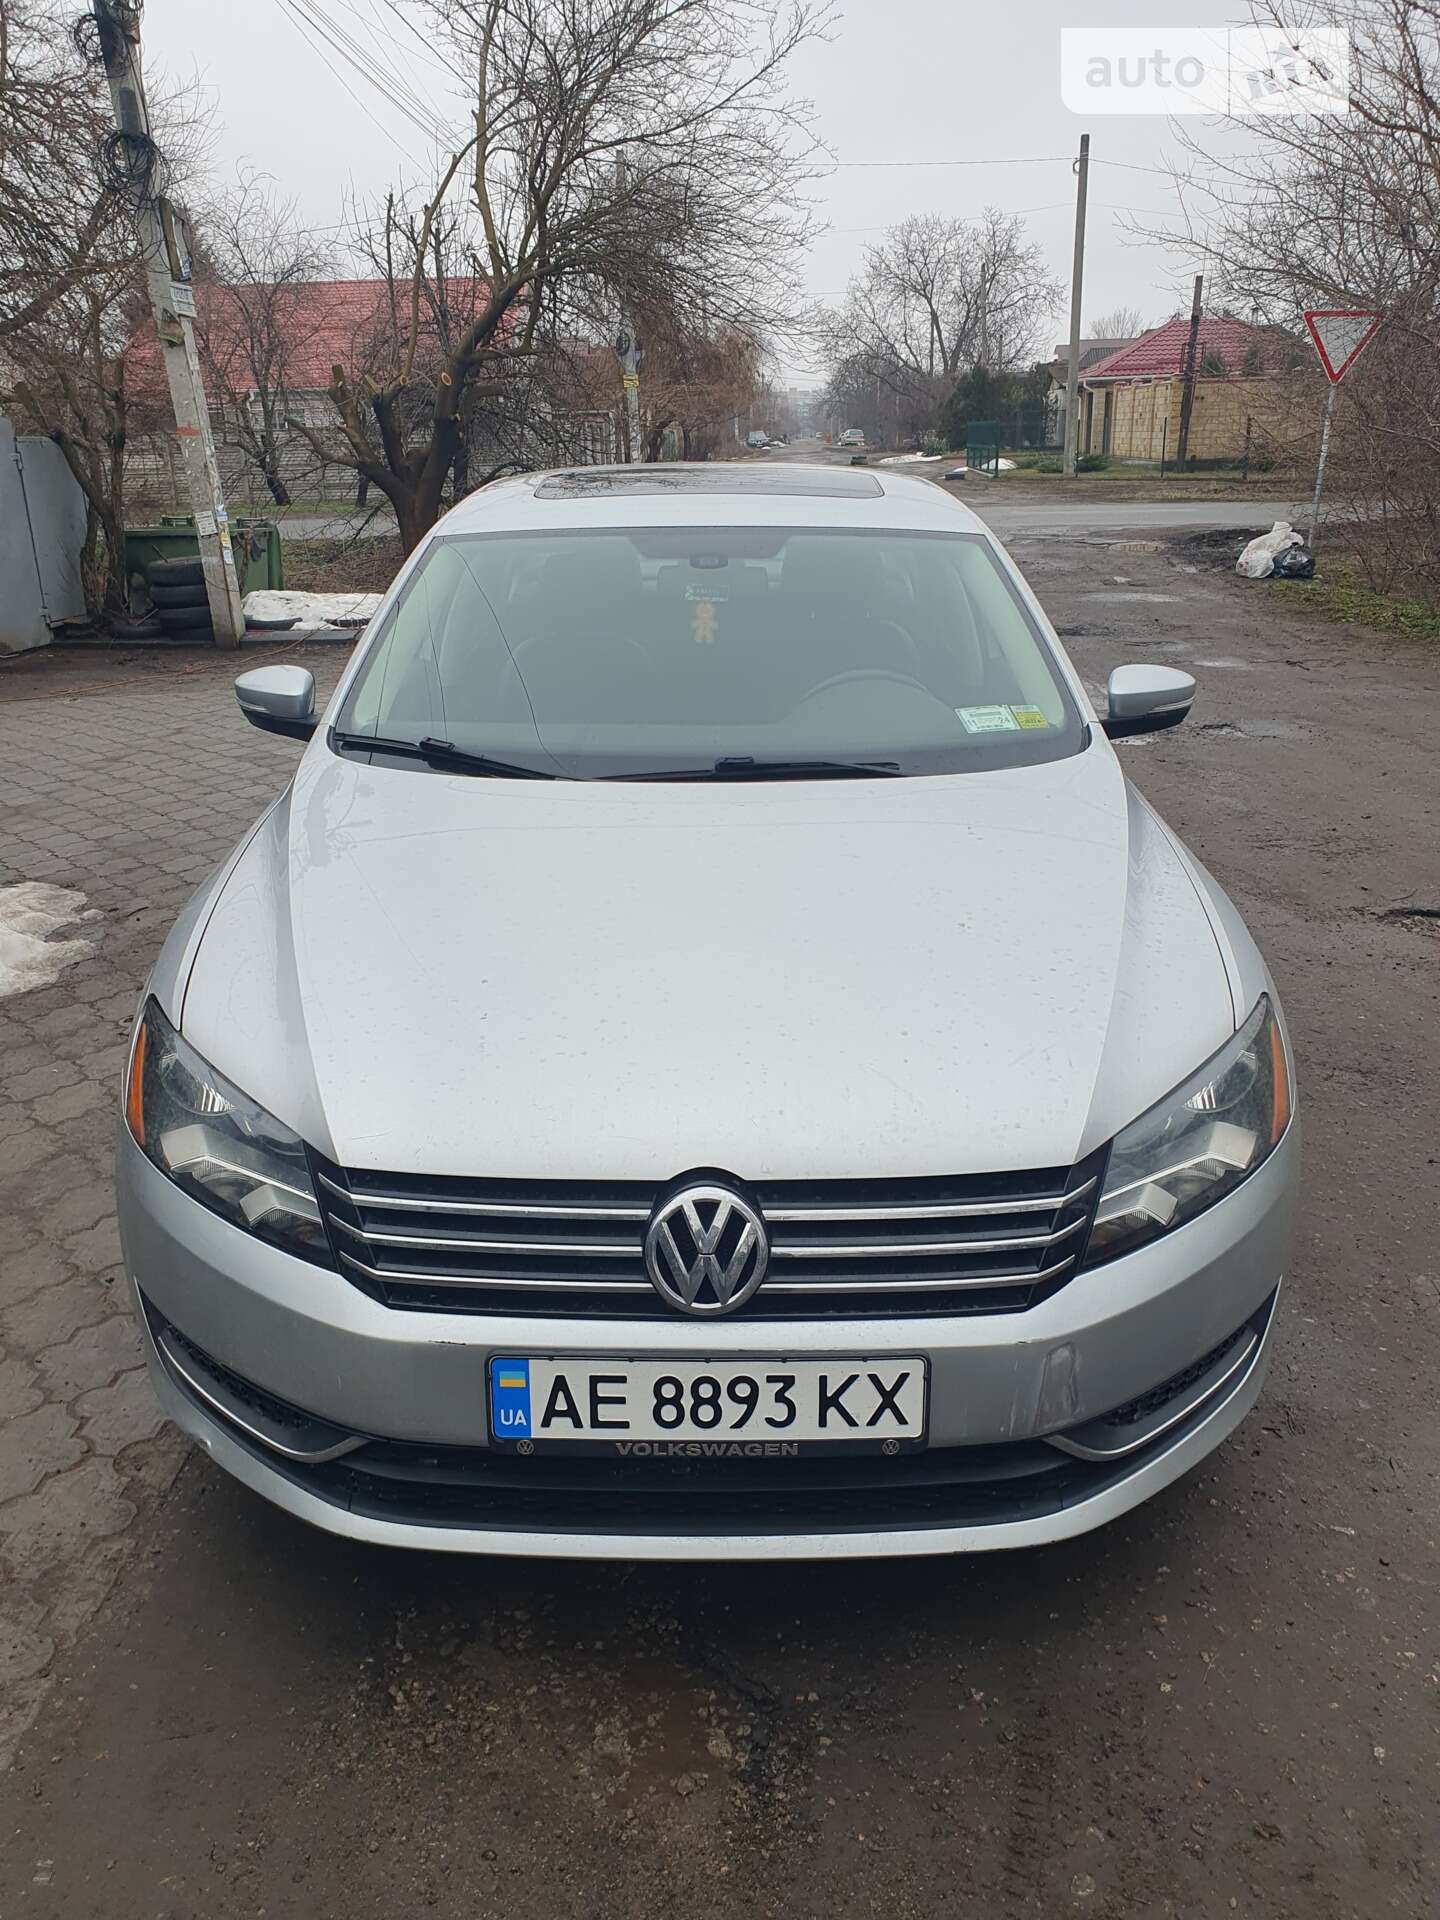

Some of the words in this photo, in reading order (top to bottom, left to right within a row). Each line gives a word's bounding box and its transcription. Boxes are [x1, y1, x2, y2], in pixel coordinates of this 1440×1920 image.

[540, 1374, 630, 1430] AE
[652, 1374, 796, 1430] 8893
[818, 1372, 910, 1428] KX
[500, 1408, 528, 1426] UA
[615, 1442, 800, 1457] VOLKSWAGEN
